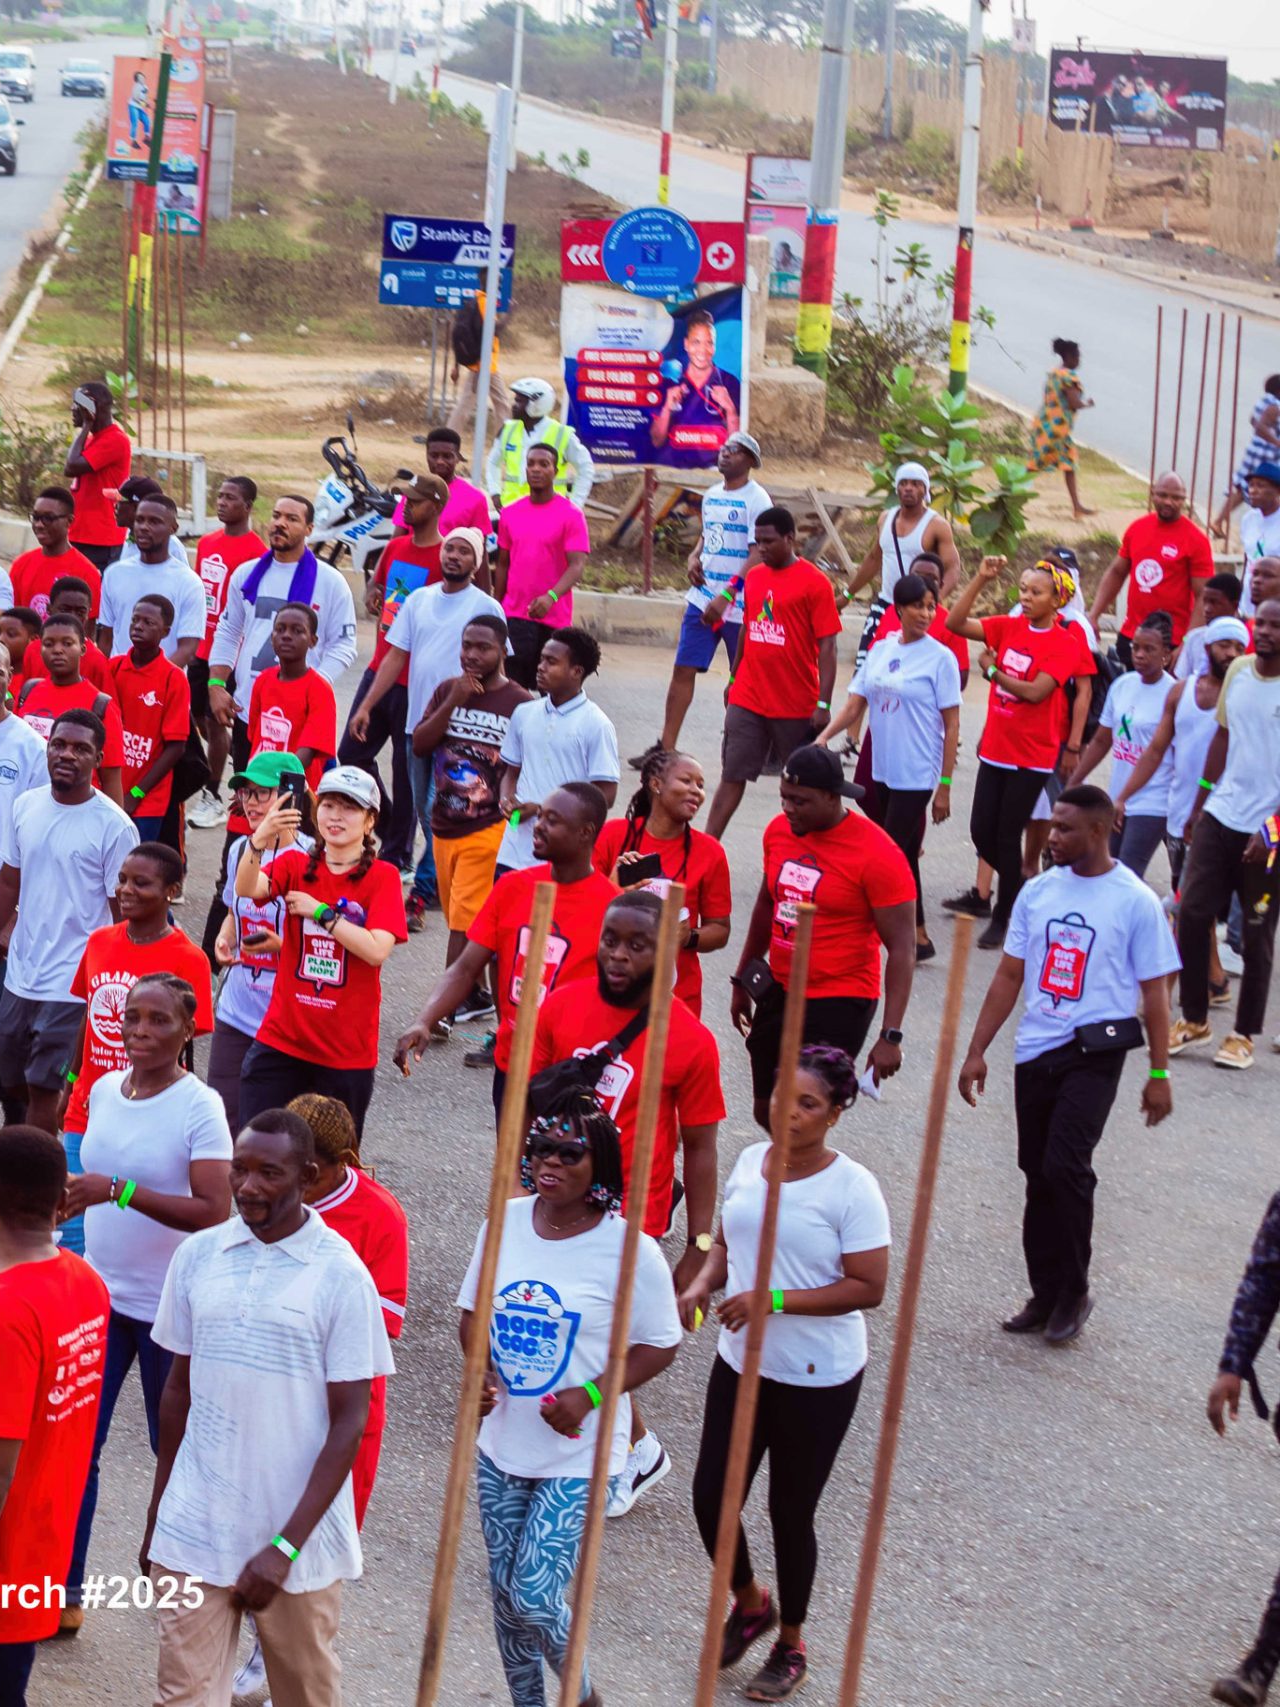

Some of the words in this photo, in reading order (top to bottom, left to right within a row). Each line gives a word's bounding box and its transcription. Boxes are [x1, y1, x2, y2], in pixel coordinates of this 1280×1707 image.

[421, 225, 471, 244] Stanbic
[122, 730, 153, 752] RCH
[311, 938, 336, 951] GIVE
[314, 948, 334, 959] LIFE
[1054, 949, 1076, 963] GIVE
[307, 957, 339, 969] PLANT
[309, 966, 336, 978] HOPE
[494, 1313, 559, 1340] ROCK
